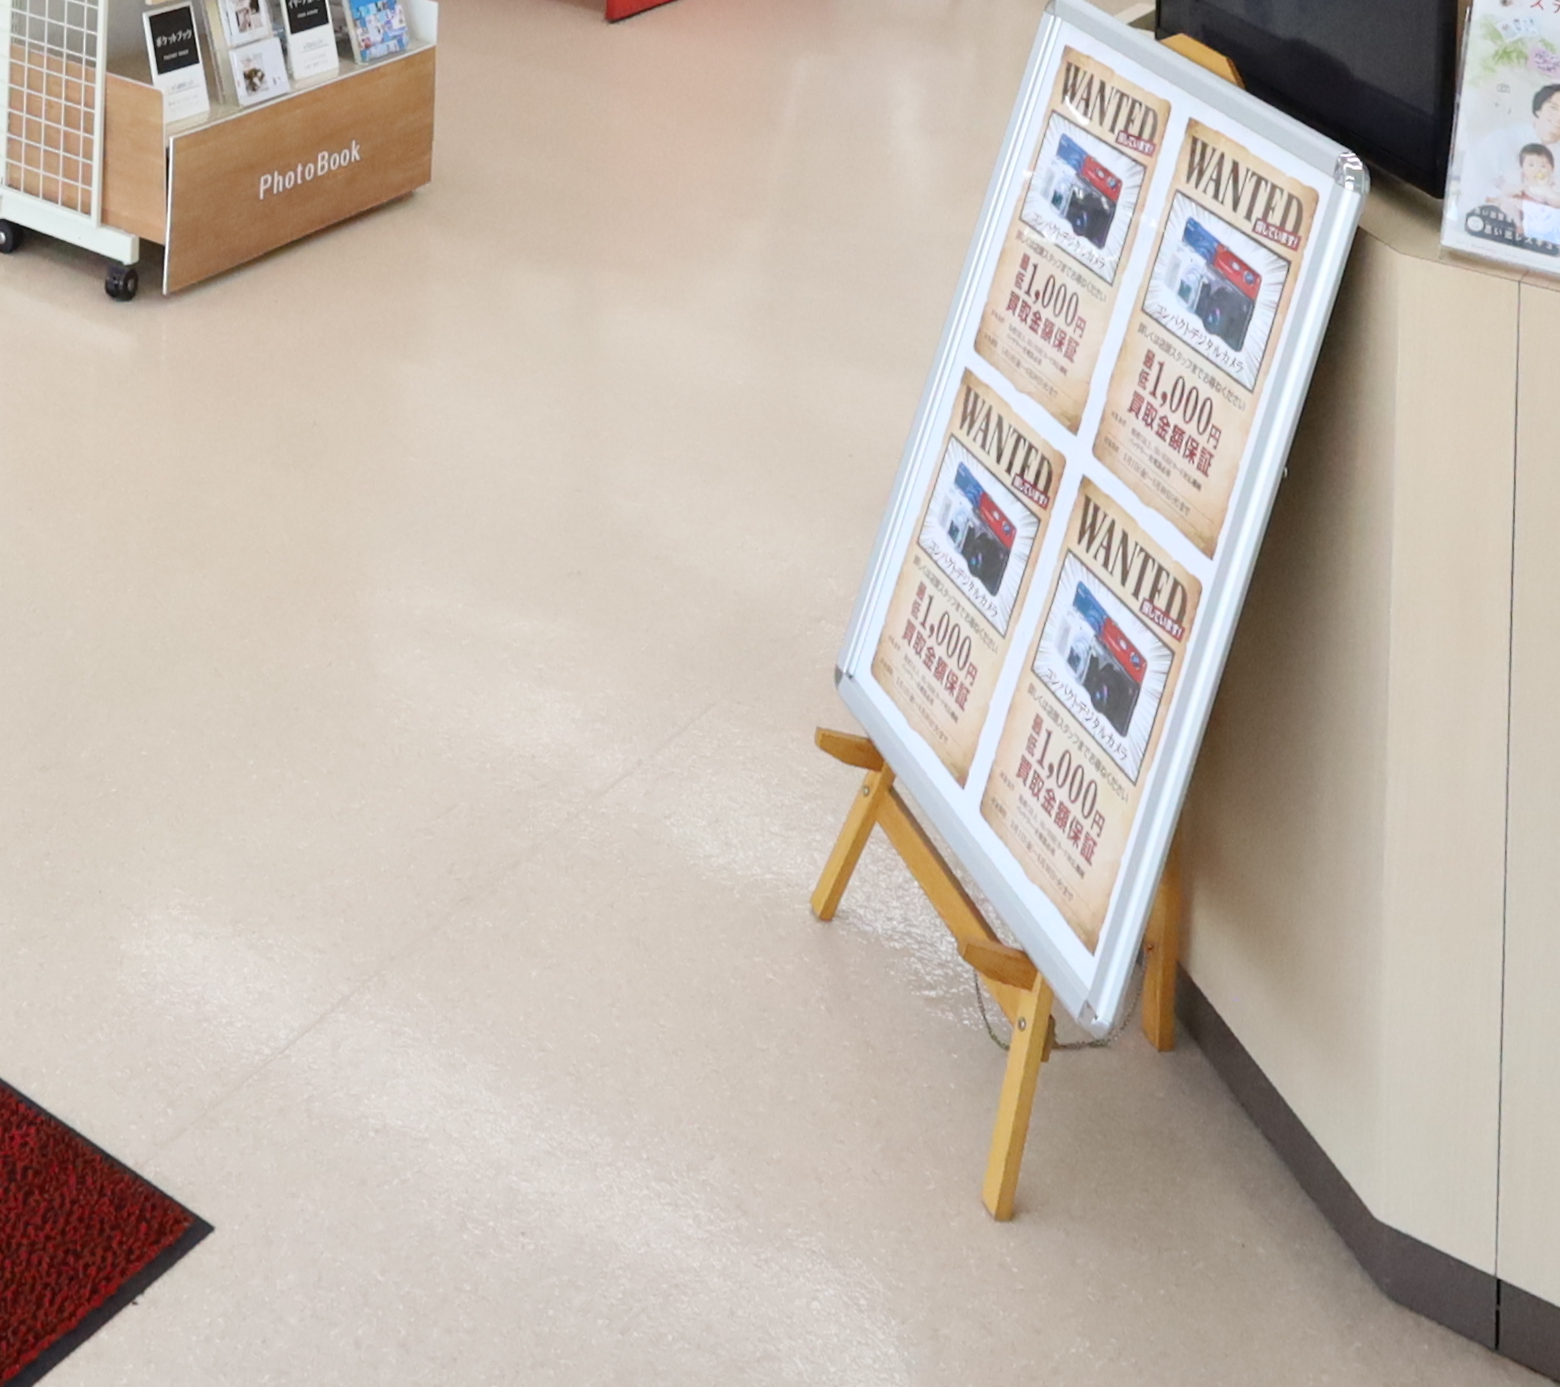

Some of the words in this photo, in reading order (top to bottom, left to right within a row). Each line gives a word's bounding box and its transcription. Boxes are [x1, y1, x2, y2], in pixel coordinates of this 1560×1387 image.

[156, 28, 192, 48] ポケットブック
[1062, 61, 1159, 141] WANTED
[259, 139, 360, 200] PhotoBook
[1185, 135, 1305, 234] WANTED
[1005, 291, 1081, 365] 買取金額保証
[1024, 262, 1088, 340] 1,000円
[1153, 302, 1245, 376] コンパクトデジタルカメラ
[1136, 348, 1156, 391] 最低
[1148, 359, 1223, 451] 1,000円
[955, 385, 1054, 496] WANTED
[1126, 391, 1215, 479] 買取金額保証
[1072, 493, 1191, 626] WANTED
[900, 626, 972, 712] 買取金額保証
[919, 593, 979, 687] 1,000円
[1044, 665, 1130, 763] コンパクトデジタルカメラ
[1014, 754, 1099, 868] 買取金額保証
[1037, 727, 1107, 837] 1,000円
